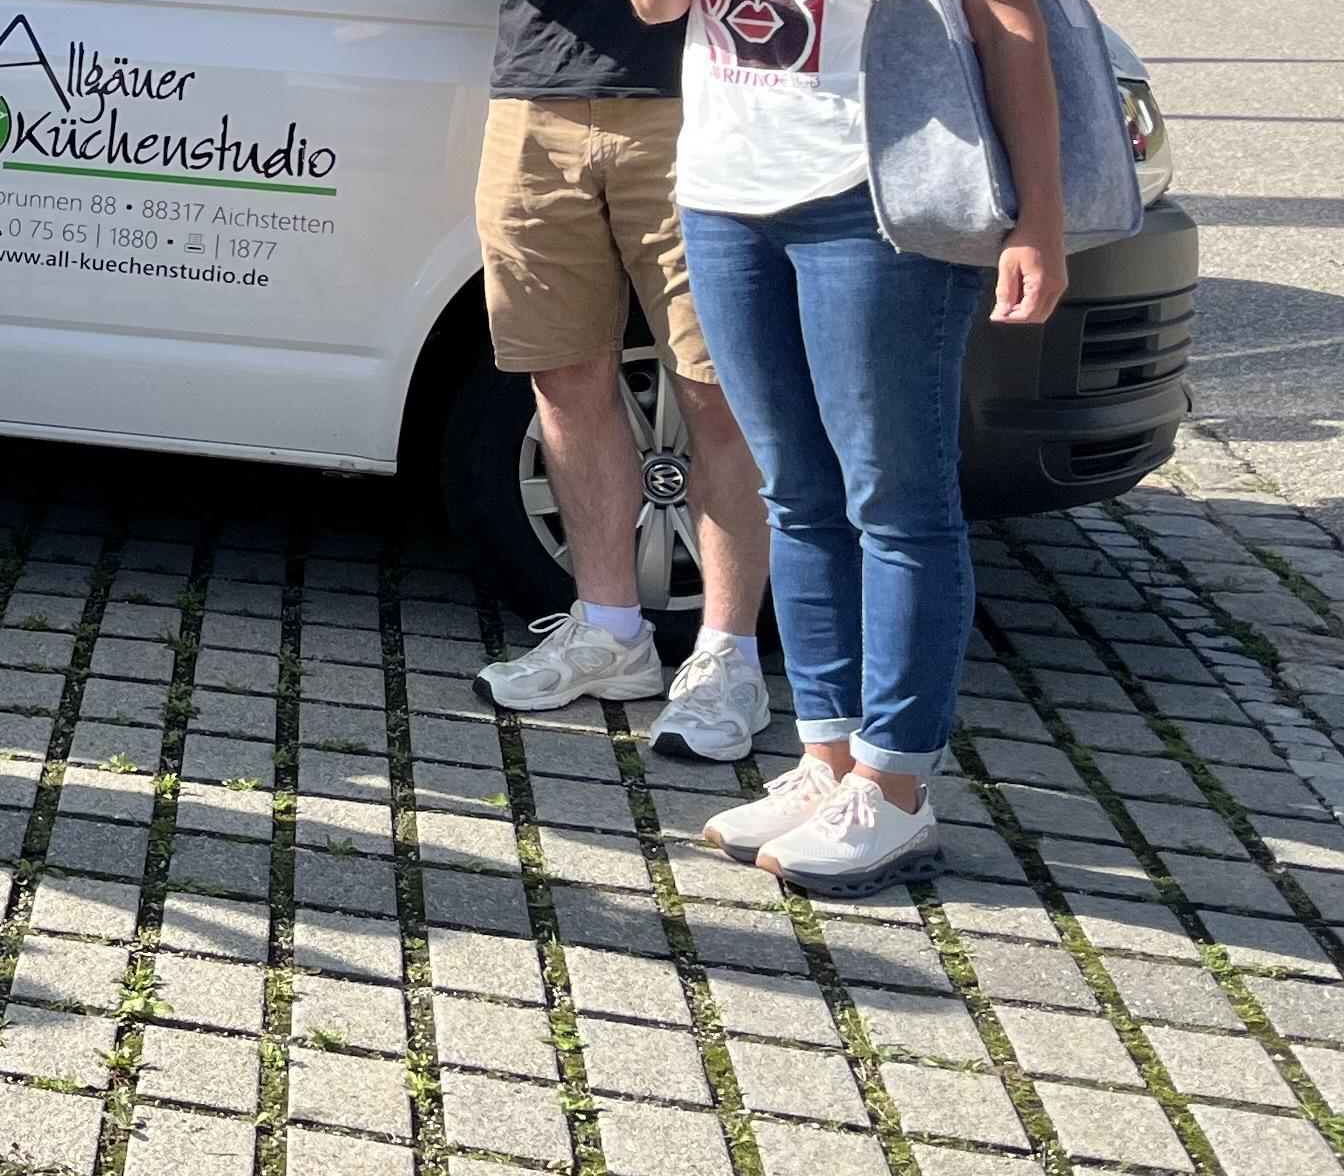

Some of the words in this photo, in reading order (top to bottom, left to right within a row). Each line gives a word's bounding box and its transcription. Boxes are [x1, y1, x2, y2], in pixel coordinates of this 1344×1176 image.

[12, 108, 337, 179] Küchenstudio
[90, 194, 117, 215] 88
[142, 199, 205, 222] 88317
[212, 206, 335, 234] Aichstetten
[9, 218, 21, 237] 0
[29, 219, 54, 240] 75
[62, 223, 87, 244] 65
[109, 227, 158, 250] 1880
[229, 238, 278, 260] 1877
